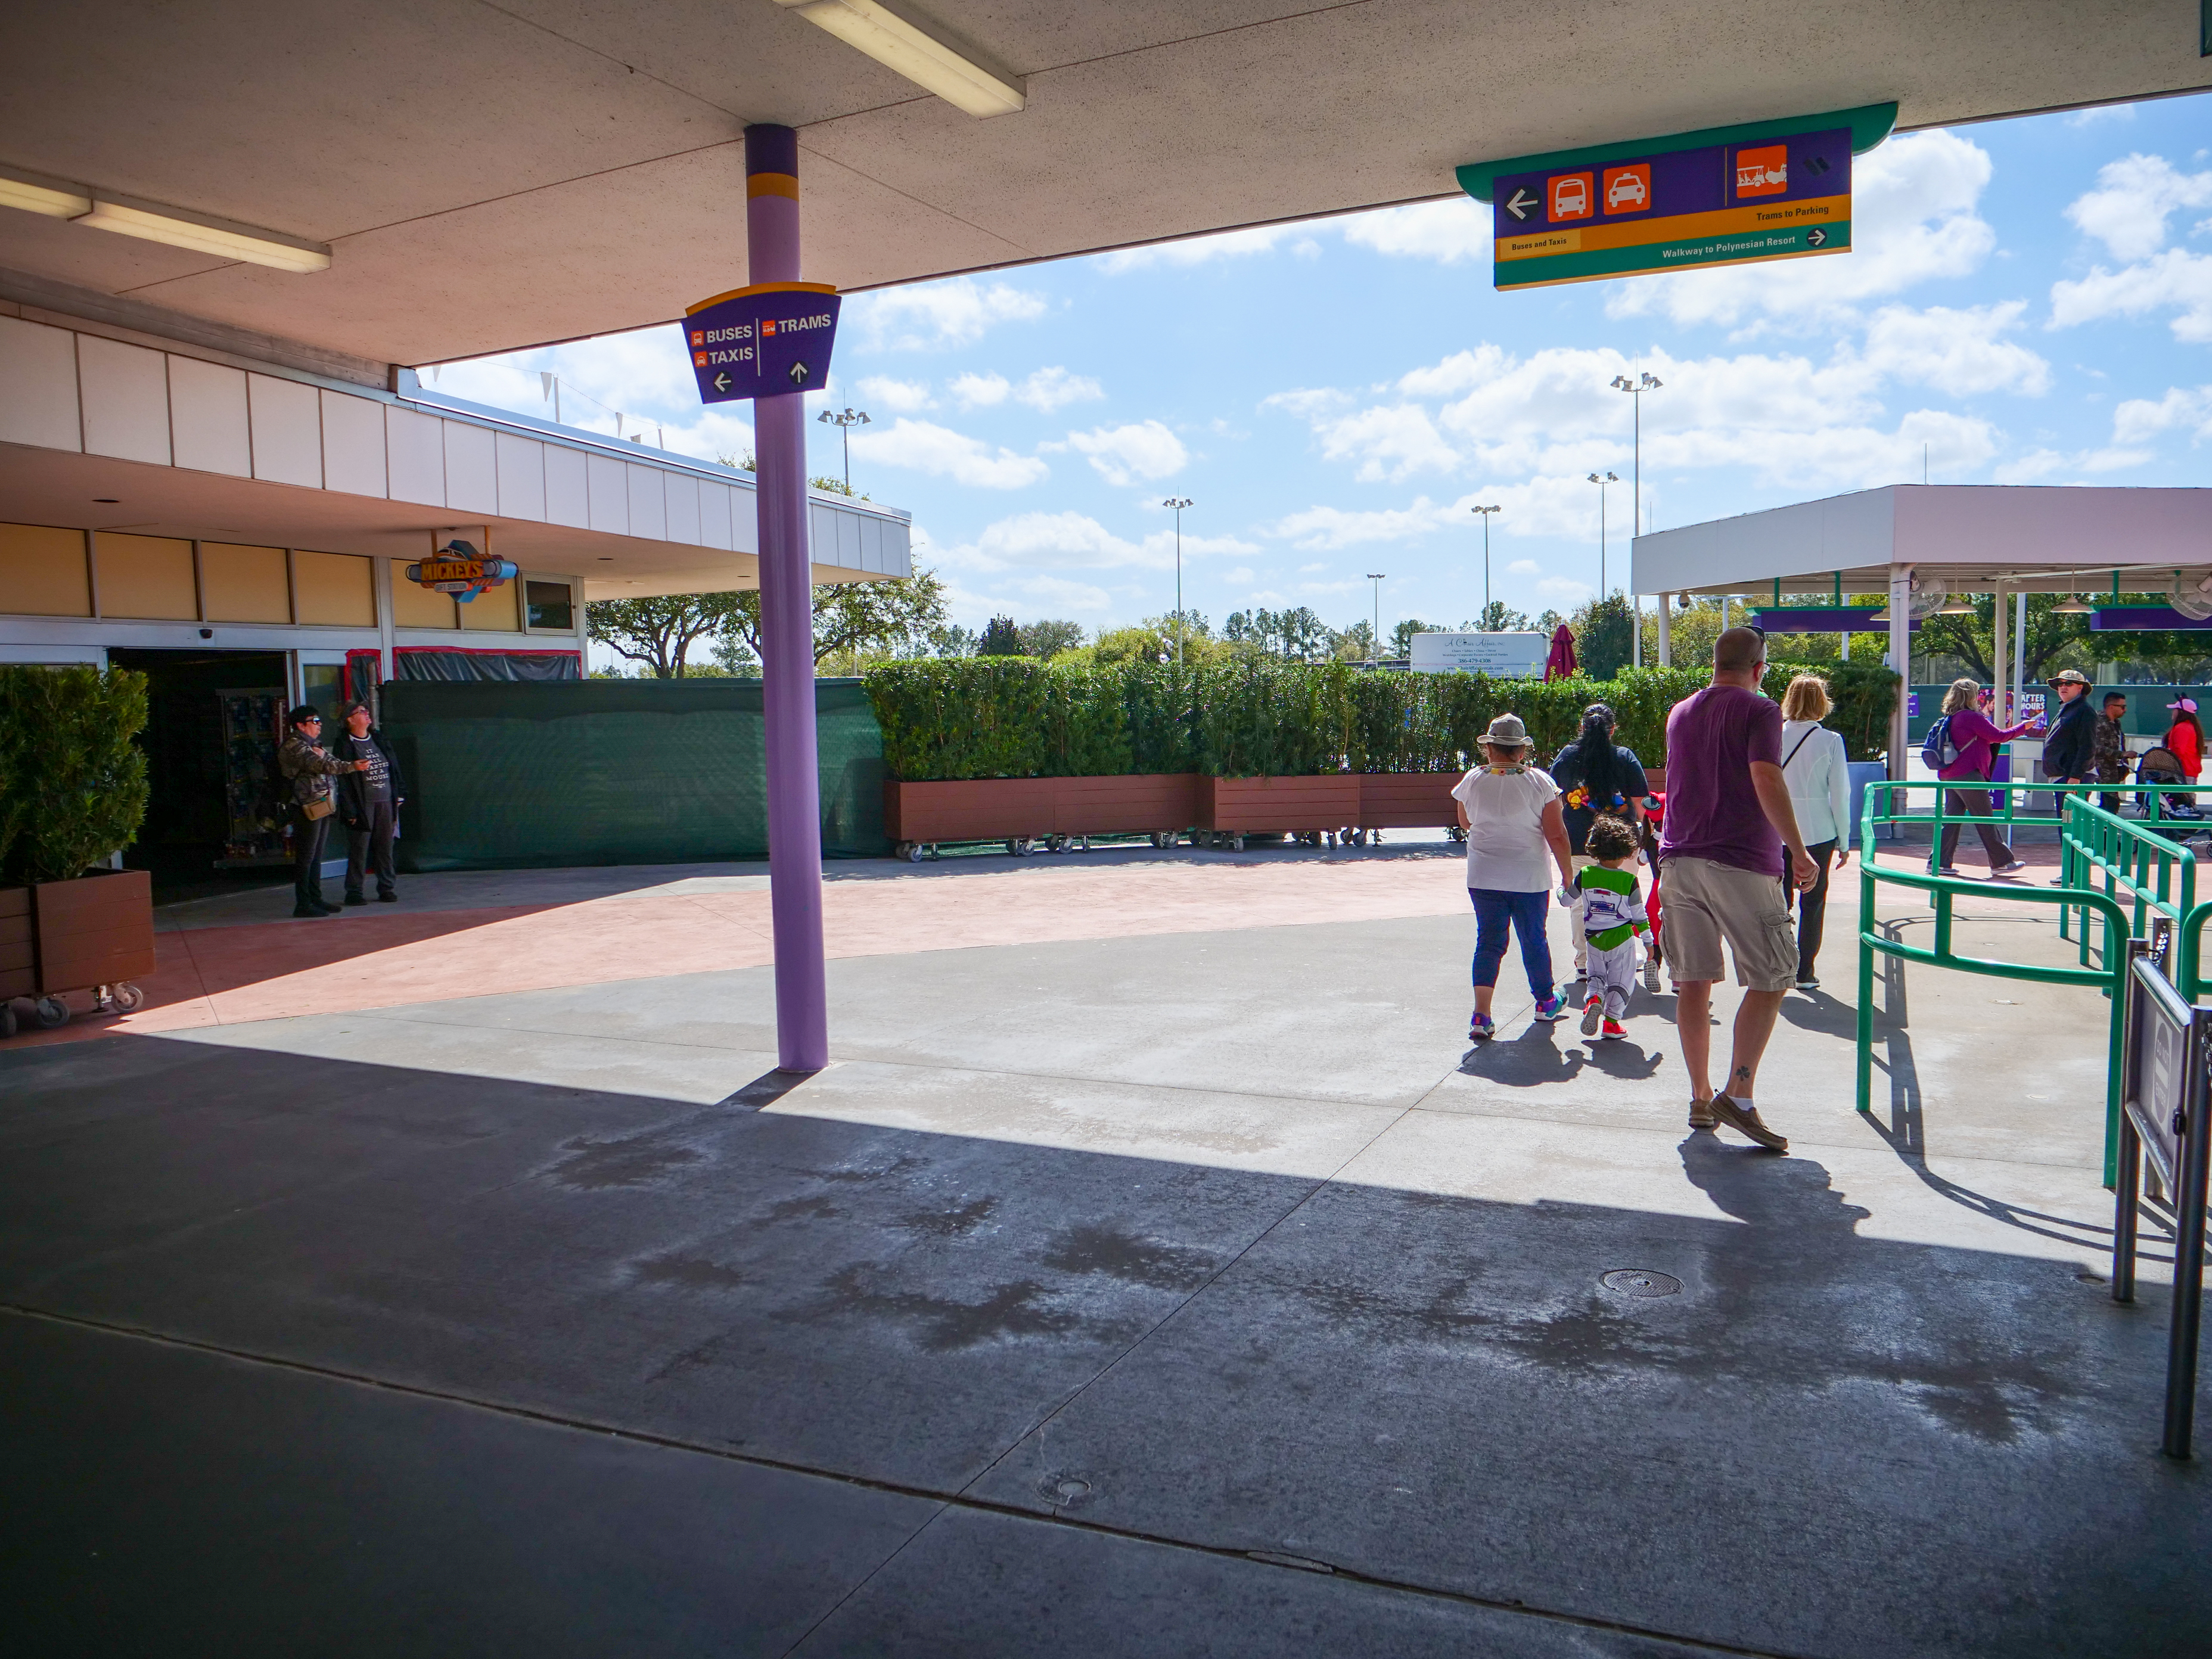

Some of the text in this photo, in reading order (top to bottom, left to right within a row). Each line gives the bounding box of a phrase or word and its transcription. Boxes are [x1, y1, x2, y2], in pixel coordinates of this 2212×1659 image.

[1757, 212, 1783, 220] Trams
[1795, 206, 1829, 216] Parking
[1663, 236, 1796, 258] Walkway to Polynesian Resort
[778, 314, 831, 333] TRAMS
[707, 325, 753, 343] BUSES
[709, 347, 753, 365] TAXIS
[1445, 638, 1453, 647] A
[2021, 694, 2045, 703] AFTER
[2021, 702, 2045, 710] HOURS
